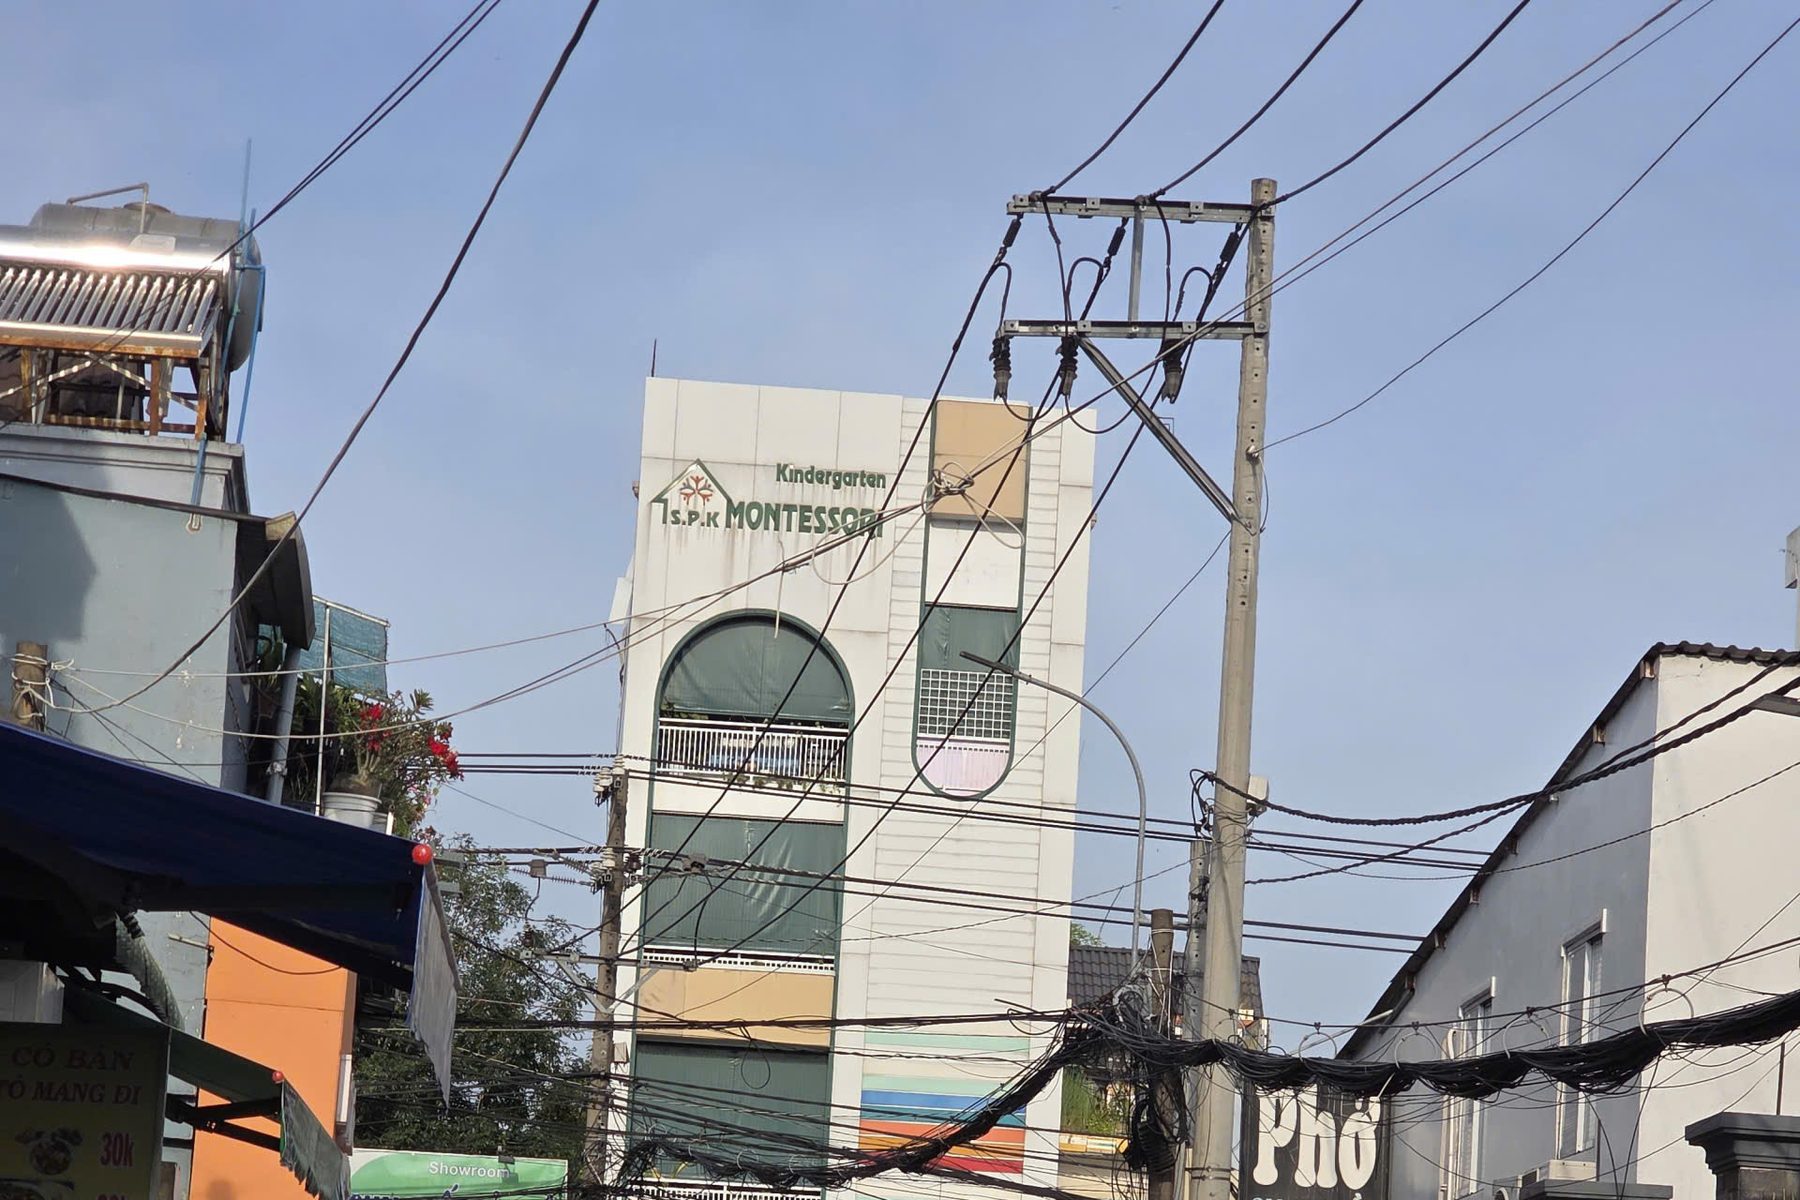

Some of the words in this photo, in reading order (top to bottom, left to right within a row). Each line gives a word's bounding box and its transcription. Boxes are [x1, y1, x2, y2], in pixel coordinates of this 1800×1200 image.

[775, 462, 887, 490] Kindergarten
[670, 509, 720, 528] S.P.K
[725, 500, 884, 539] MONTESSORI
[32, 1081, 105, 1103] MANG
[112, 1085, 143, 1105] ĐI
[100, 1132, 135, 1167] 30k
[1252, 1083, 1381, 1190] Phở
[428, 1161, 511, 1179] Showroom
